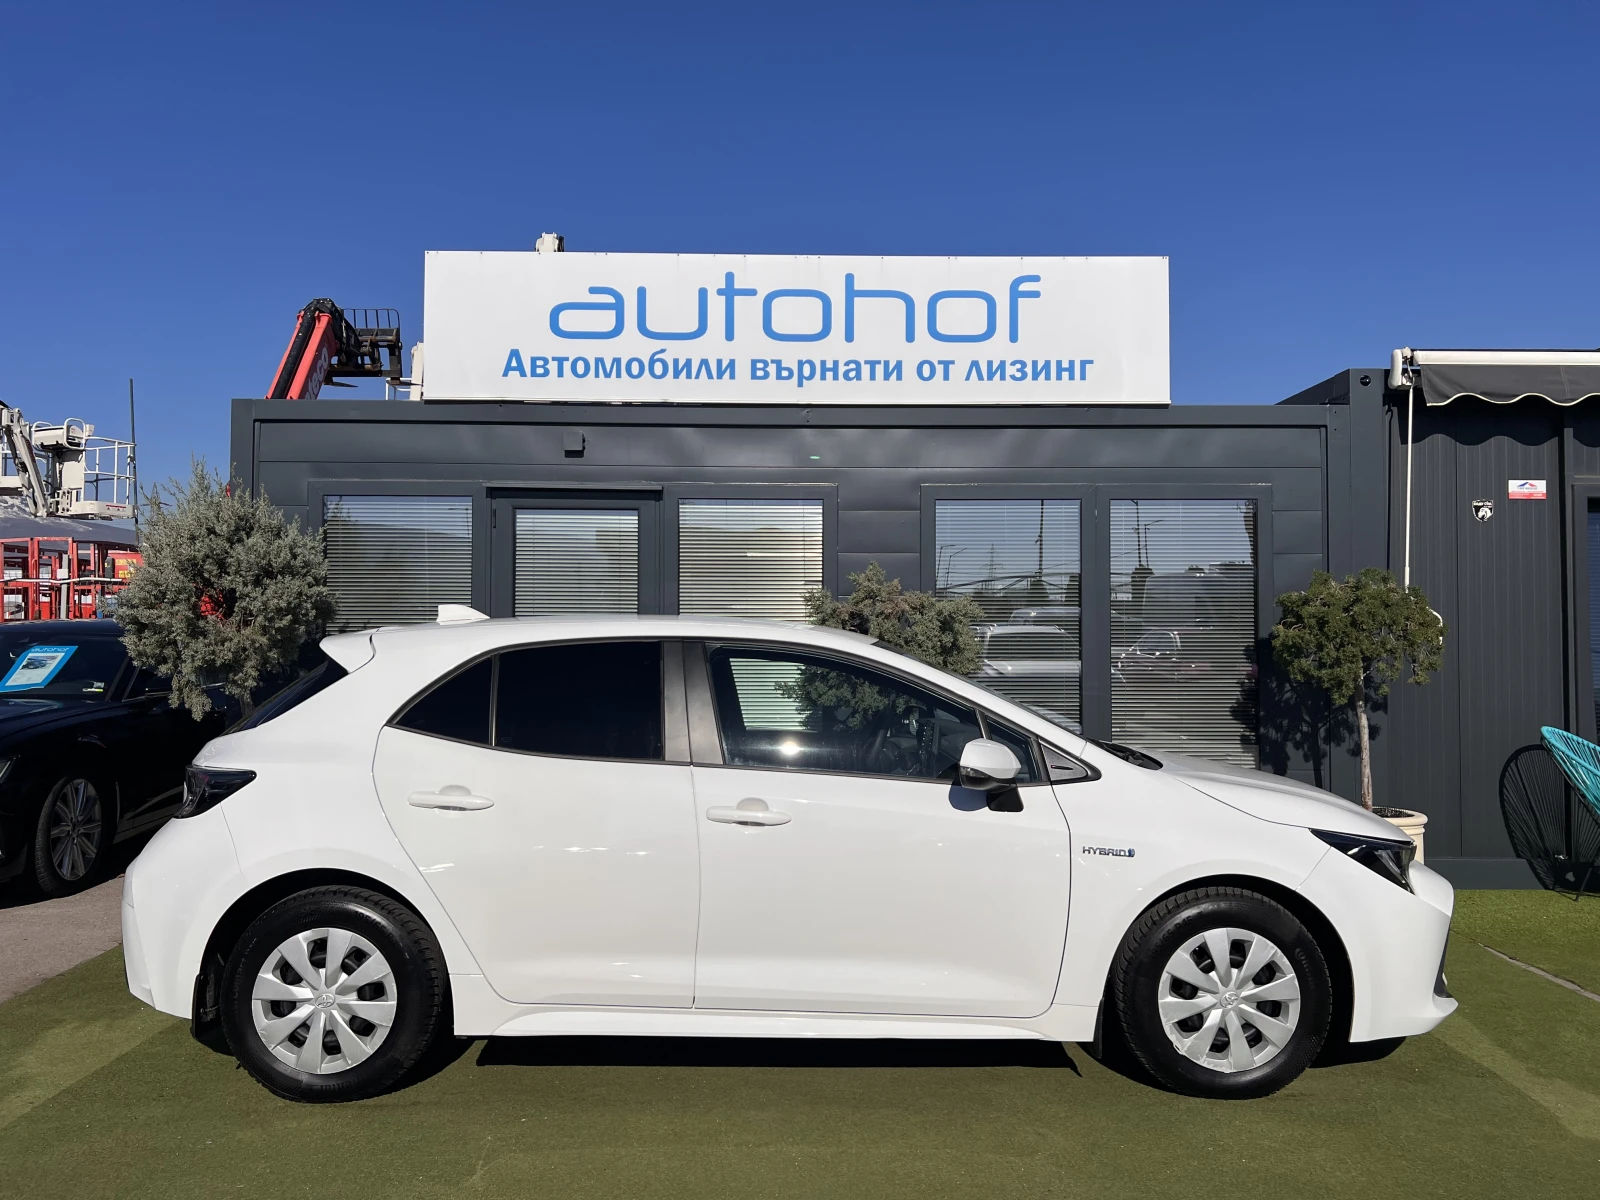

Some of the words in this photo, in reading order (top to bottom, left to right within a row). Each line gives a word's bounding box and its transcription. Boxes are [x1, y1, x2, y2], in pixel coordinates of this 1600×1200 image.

[550, 272, 1042, 343] autohof
[502, 349, 736, 380] Автомобили
[750, 359, 903, 387] върнати
[917, 360, 956, 381] от
[965, 360, 1094, 382] лизинг
[1082, 846, 1127, 857] HYBRID
